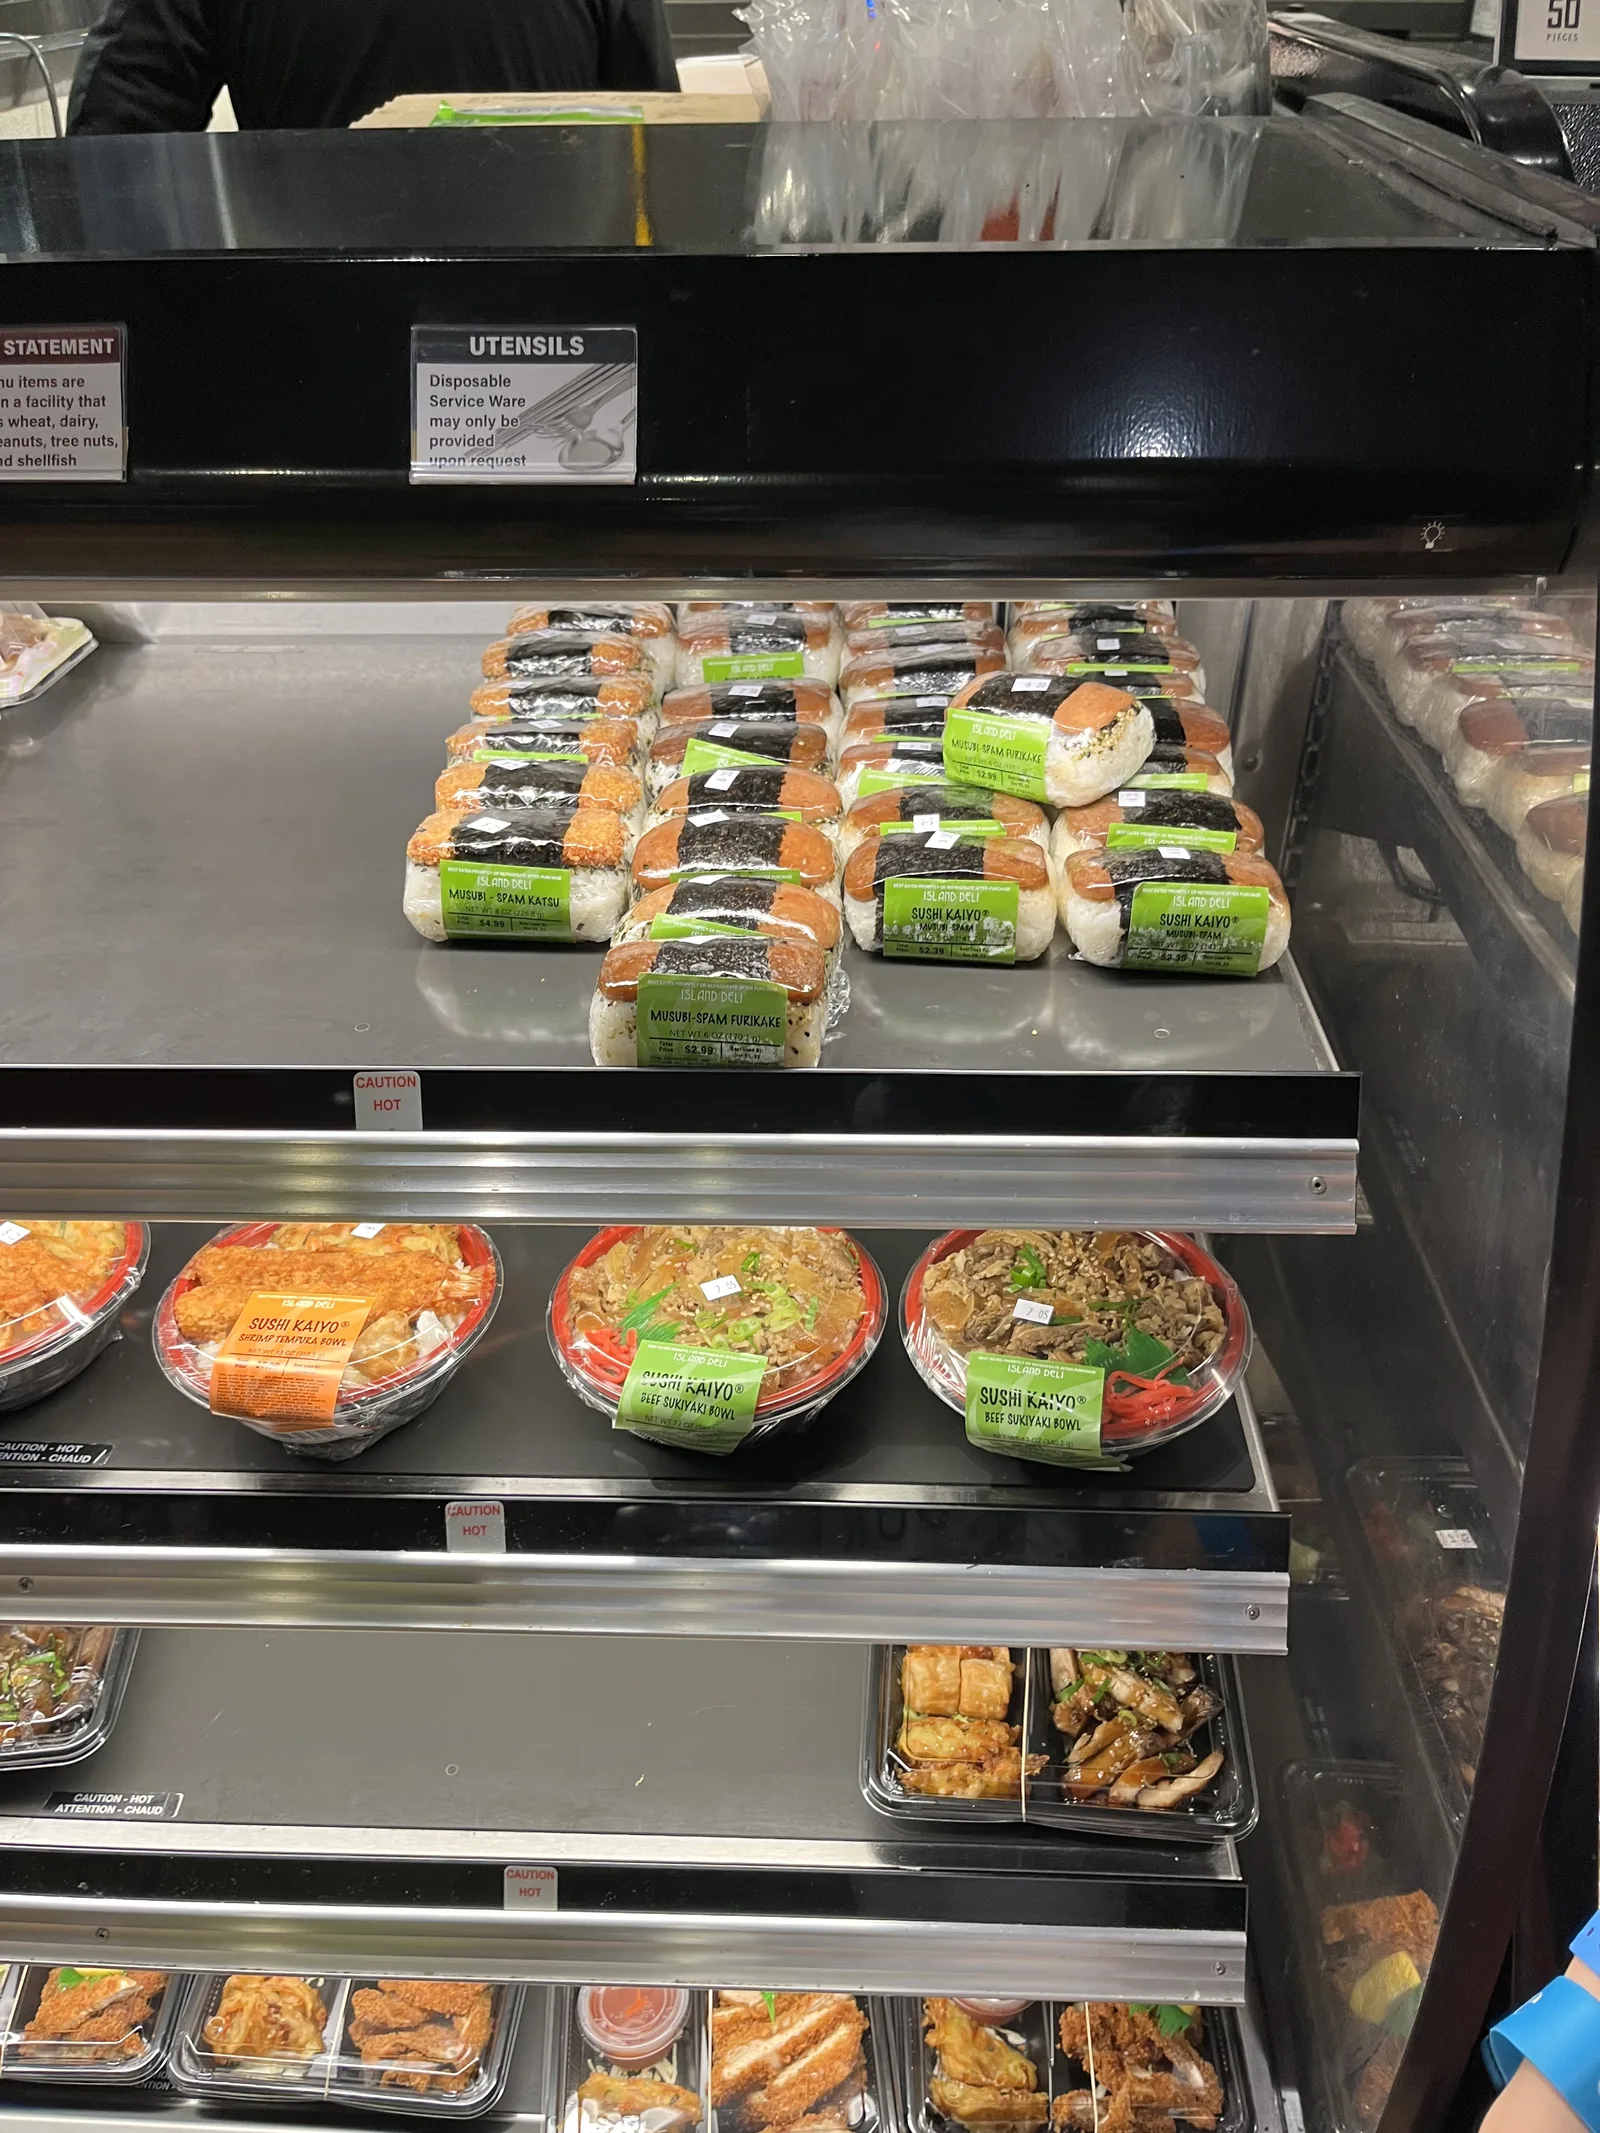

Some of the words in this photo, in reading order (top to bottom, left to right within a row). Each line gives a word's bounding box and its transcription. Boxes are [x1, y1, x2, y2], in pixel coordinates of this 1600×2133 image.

[1547, 0, 1580, 28] 50
[1546, 33, 1578, 42] PIECES
[4, 338, 114, 355] STATEMENT
[469, 336, 585, 356] UTENSILS
[19, 375, 57, 388] items
[62, 378, 85, 388] are
[429, 374, 511, 390] Disposable
[14, 398, 21, 408] a
[26, 395, 74, 411] facility
[79, 395, 106, 408] that
[429, 395, 485, 408] Service
[489, 395, 526, 408] Ware
[8, 415, 55, 430] wheat,
[60, 414, 99, 430] dairy,
[429, 417, 460, 429] may
[465, 414, 496, 429] only
[501, 415, 519, 428] be
[51, 436, 79, 447] tree
[84, 435, 118, 449] nuts,
[429, 435, 495, 449] provided
[18, 454, 77, 467] shellfish
[429, 456, 466, 469] upon
[470, 455, 527, 469] request
[972, 723, 998, 737] ISLAND
[999, 728, 1016, 741] DELI
[951, 739, 1004, 758] MUSUBI-SPAM
[1006, 748, 1042, 764] FURIKAKE
[976, 769, 997, 781] $2.99
[477, 875, 510, 889] ISLAND
[512, 878, 532, 890] DELI
[449, 888, 486, 902] MUSUBI
[496, 892, 525, 905] SPAM
[528, 895, 560, 908] KATSU
[923, 892, 956, 902] ISLAND
[959, 893, 979, 903] DELI
[1172, 895, 1207, 907] ISLAND
[1209, 897, 1230, 909] DELI
[911, 908, 942, 920] SUSHI
[1159, 913, 1191, 927] SUSHI
[480, 920, 505, 928] $4.99
[919, 923, 974, 932] MUSUBI-SPAM
[1166, 930, 1222, 939] MUSUBI-SPAM
[919, 946, 944, 955] $2.39
[1160, 953, 1187, 962] $2.39
[681, 989, 717, 1002] ISLAND
[722, 991, 743, 1004] DELI
[650, 1010, 727, 1026] MUSUBI-SPAM
[731, 1015, 781, 1028] FURIKAKE
[670, 1029, 686, 1037] NET
[685, 1044, 714, 1055] $2.99
[355, 1076, 416, 1088] CAUTION
[373, 1099, 401, 1111] HOT
[315, 1301, 335, 1309] DELI
[249, 1318, 291, 1331] SUSHI
[238, 1333, 274, 1343] SHRIMP
[276, 1335, 317, 1345] TEMPURA
[320, 1337, 347, 1346] BOWL
[673, 1352, 705, 1364] ISLAND
[707, 1358, 727, 1367] DELI
[1007, 1363, 1041, 1376] ISLAND
[1043, 1368, 1064, 1379] DELI
[641, 1371, 682, 1391] SUSHI
[980, 1386, 1022, 1407] SUSHI
[641, 1392, 661, 1405] BEEF
[663, 1396, 706, 1414] SUKIYAKI
[709, 1407, 735, 1420] BOWL
[644, 1414, 658, 1423] NET
[985, 1412, 1005, 1424] BEEF
[1007, 1413, 1051, 1429] SUKIYAKI
[1053, 1418, 1081, 1431] BOWL
[0, 1442, 48, 1451] CAUTION
[56, 1444, 83, 1453] HOT
[48, 1453, 92, 1463] CHAUD
[448, 1505, 501, 1516] CAUTION
[463, 1525, 487, 1536] HOT
[73, 1793, 123, 1803] CAUTION
[129, 1795, 155, 1804] HOT
[55, 1804, 116, 1814] ATTENTION
[123, 1805, 163, 1815] CHAUD
[506, 1869, 555, 1880] CAUTION
[519, 1887, 542, 1897] HOT
